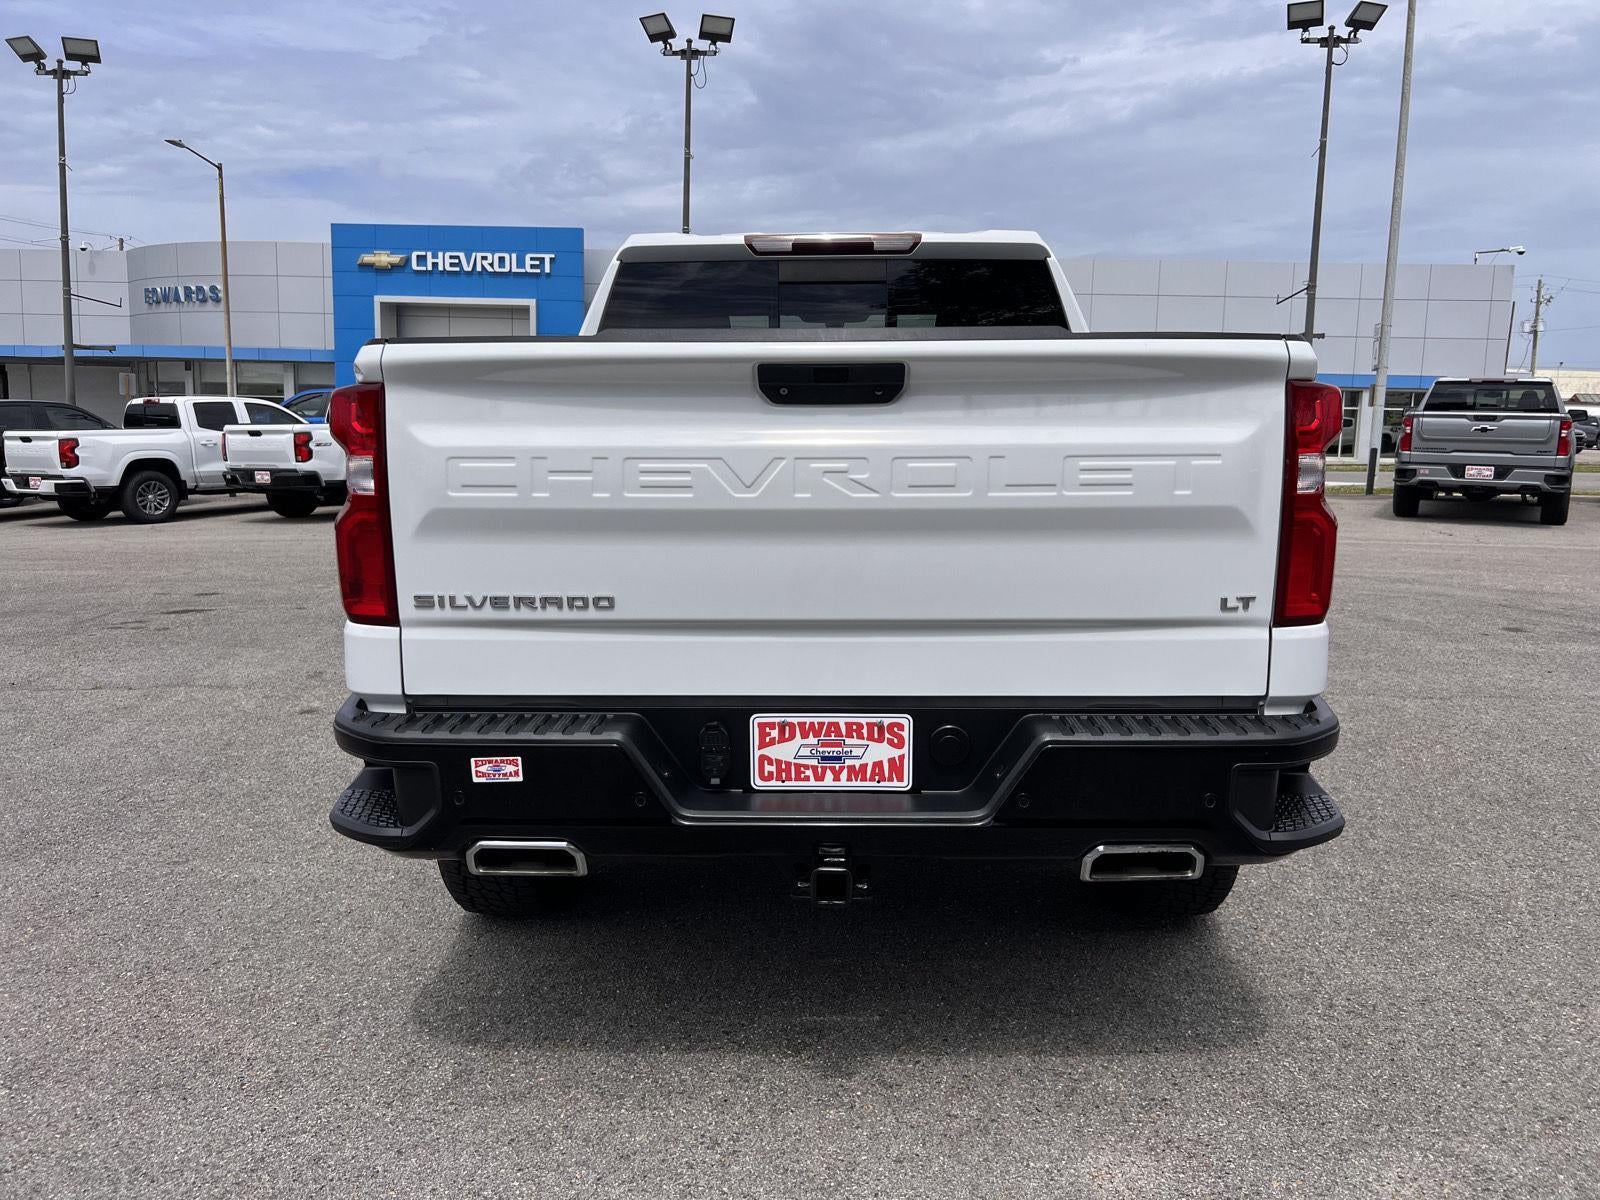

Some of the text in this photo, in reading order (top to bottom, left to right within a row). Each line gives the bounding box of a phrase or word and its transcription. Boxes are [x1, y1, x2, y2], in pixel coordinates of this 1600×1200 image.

[411, 251, 555, 274] CHEVROLET
[144, 285, 222, 304] EDWARDS
[446, 453, 1223, 498] CHEVROLET
[413, 595, 616, 610] SILVERADO
[1220, 596, 1256, 613] LT
[757, 721, 906, 750] EDWARDS
[809, 748, 854, 756] Chevrolet
[474, 758, 519, 768] EDWARDS
[757, 753, 906, 783] CHEVYMAN
[475, 769, 520, 778] CHEVYMAN
